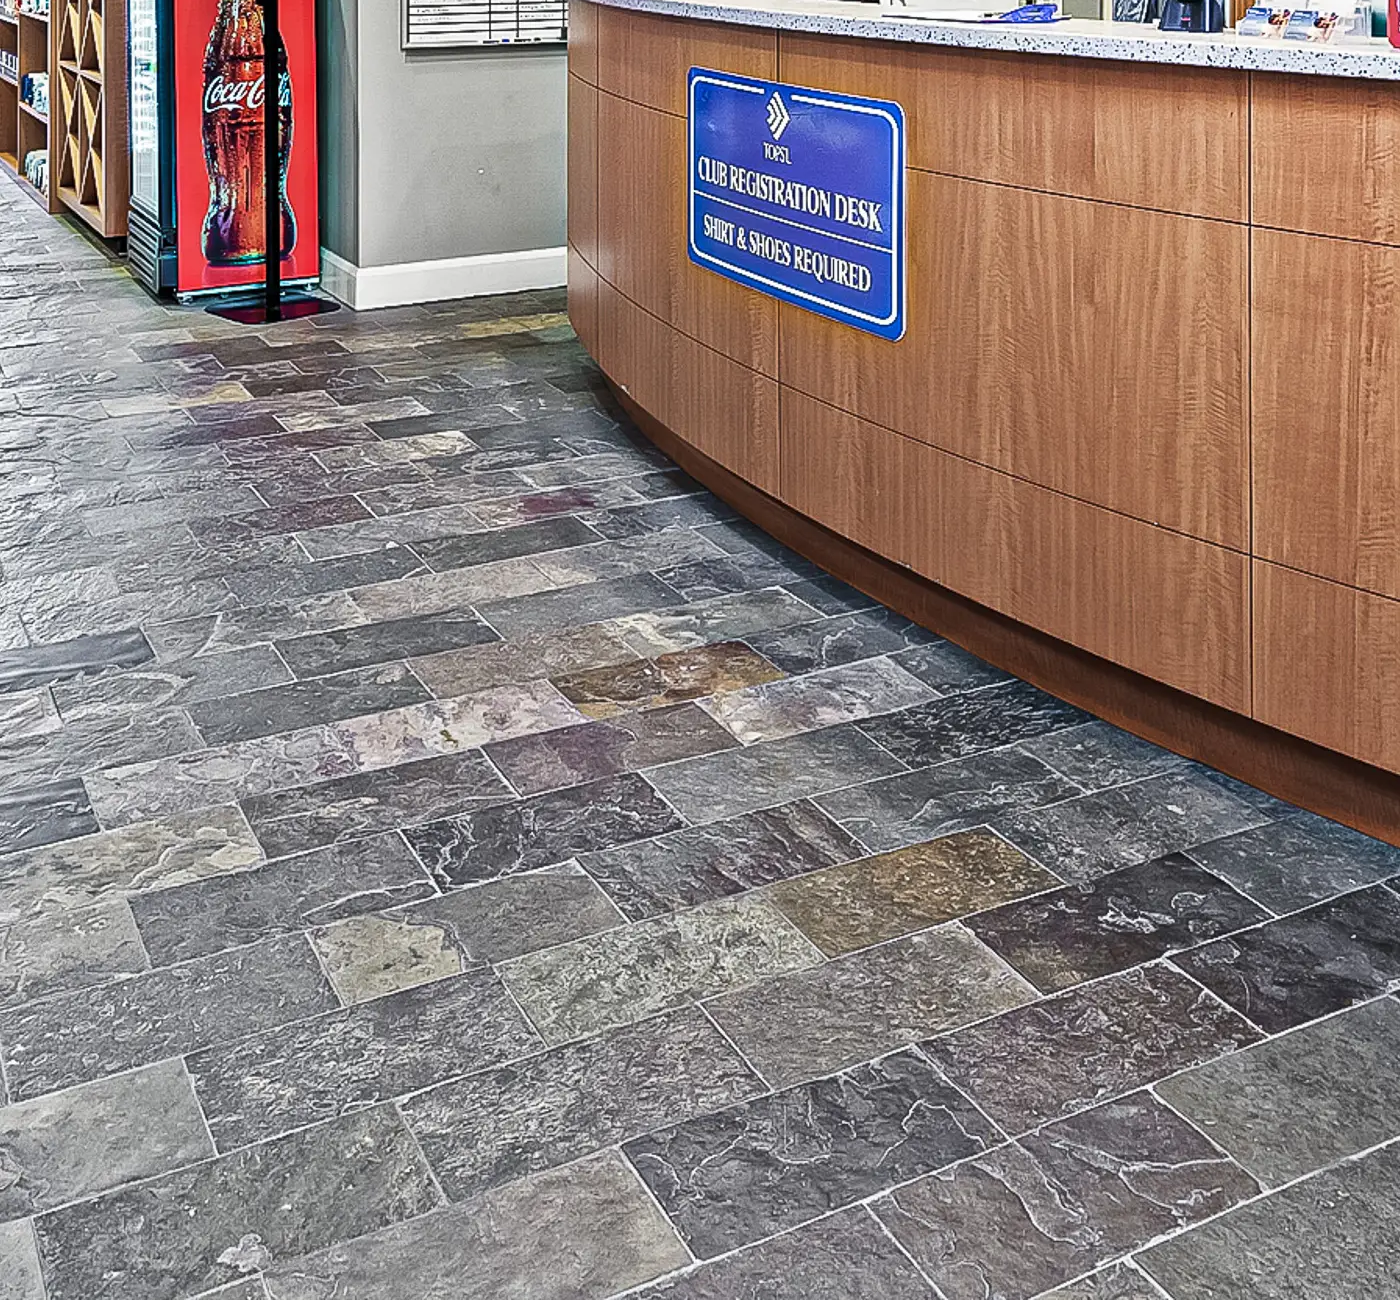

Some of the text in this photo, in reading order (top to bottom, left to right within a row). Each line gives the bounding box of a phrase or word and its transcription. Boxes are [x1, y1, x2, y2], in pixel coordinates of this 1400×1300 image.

[698, 155, 883, 233] CLUB REGISTRATION DESK
[703, 214, 872, 293] SHIRT & SHOES REQUIRED
